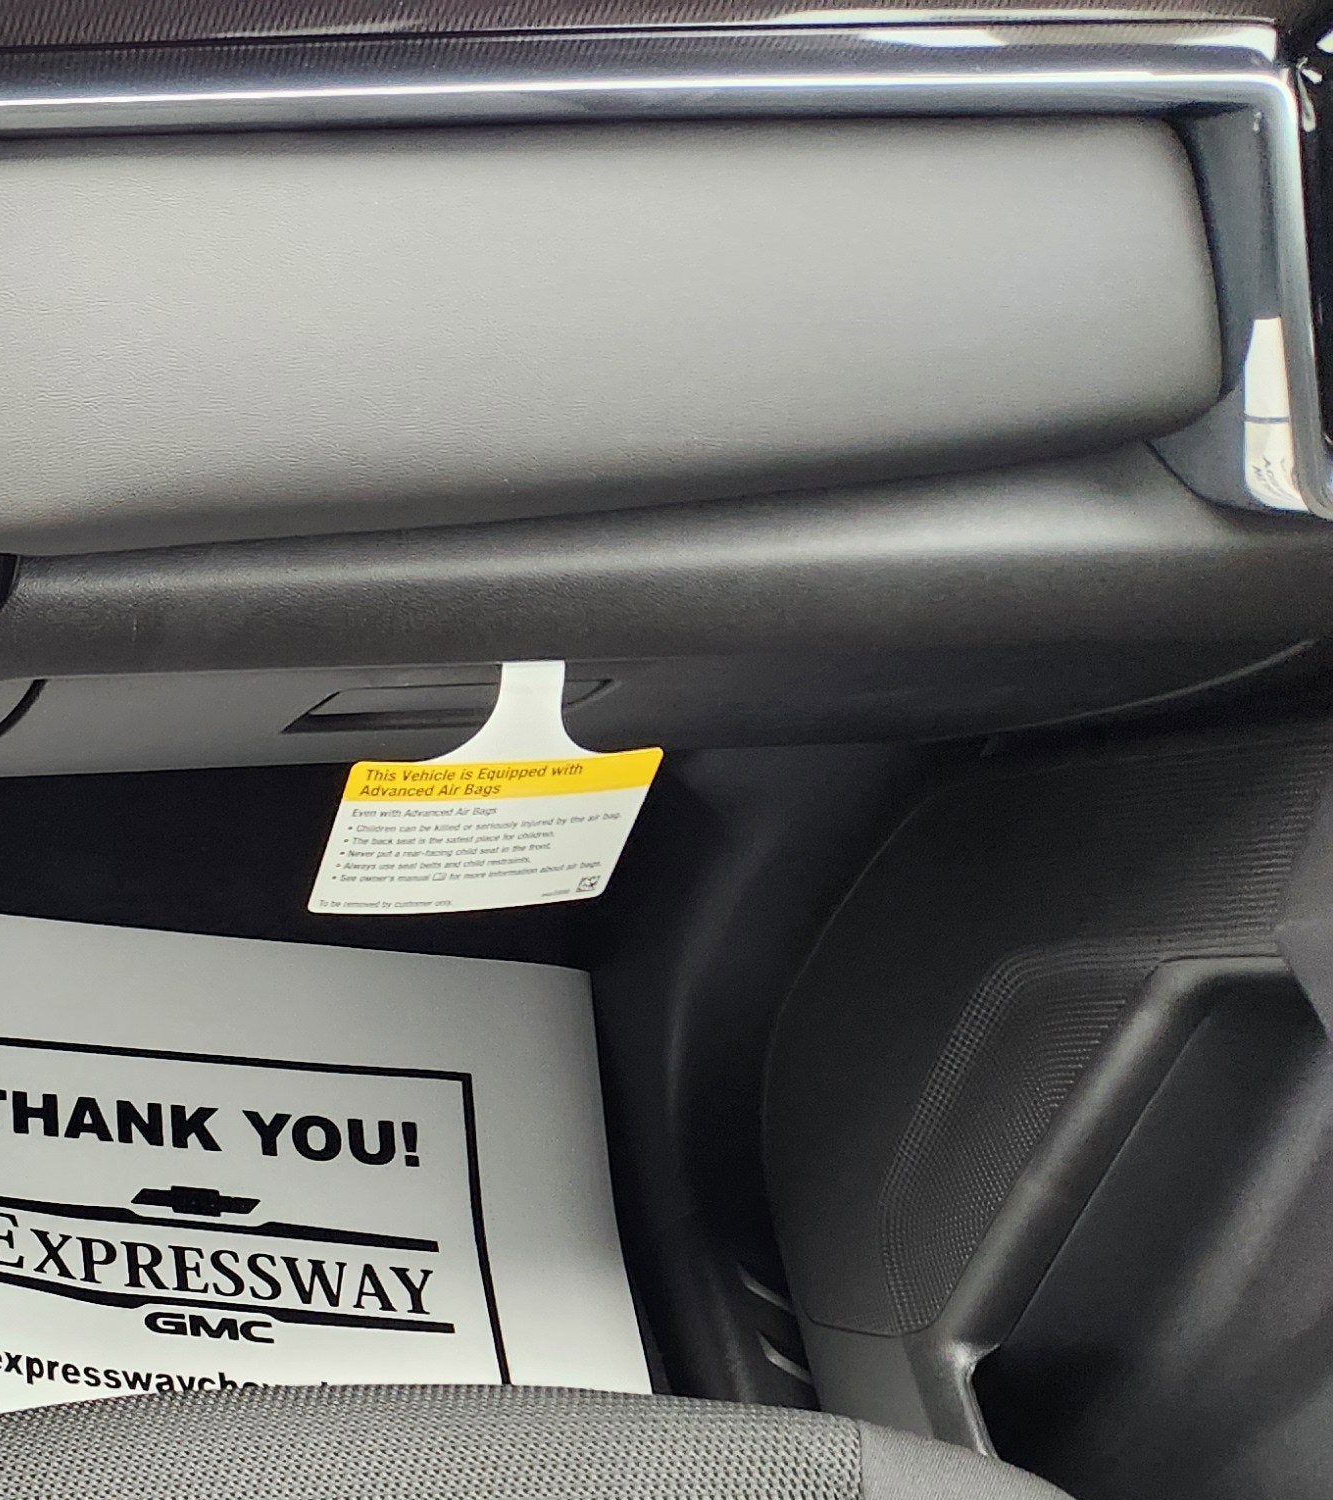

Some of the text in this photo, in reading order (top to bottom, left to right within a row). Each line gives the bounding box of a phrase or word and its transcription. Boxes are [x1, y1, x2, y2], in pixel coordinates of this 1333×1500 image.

[366, 763, 584, 782] This Vehicle is Equipped with
[359, 783, 502, 797] Advanced Air Bags
[380, 808, 402, 818] with
[404, 808, 454, 818] Advanced
[473, 807, 498, 817] Bags
[356, 824, 397, 833] Children
[435, 823, 461, 832] killed
[242, 1109, 421, 1168] YOU!
[143, 1312, 276, 1345] GMC
